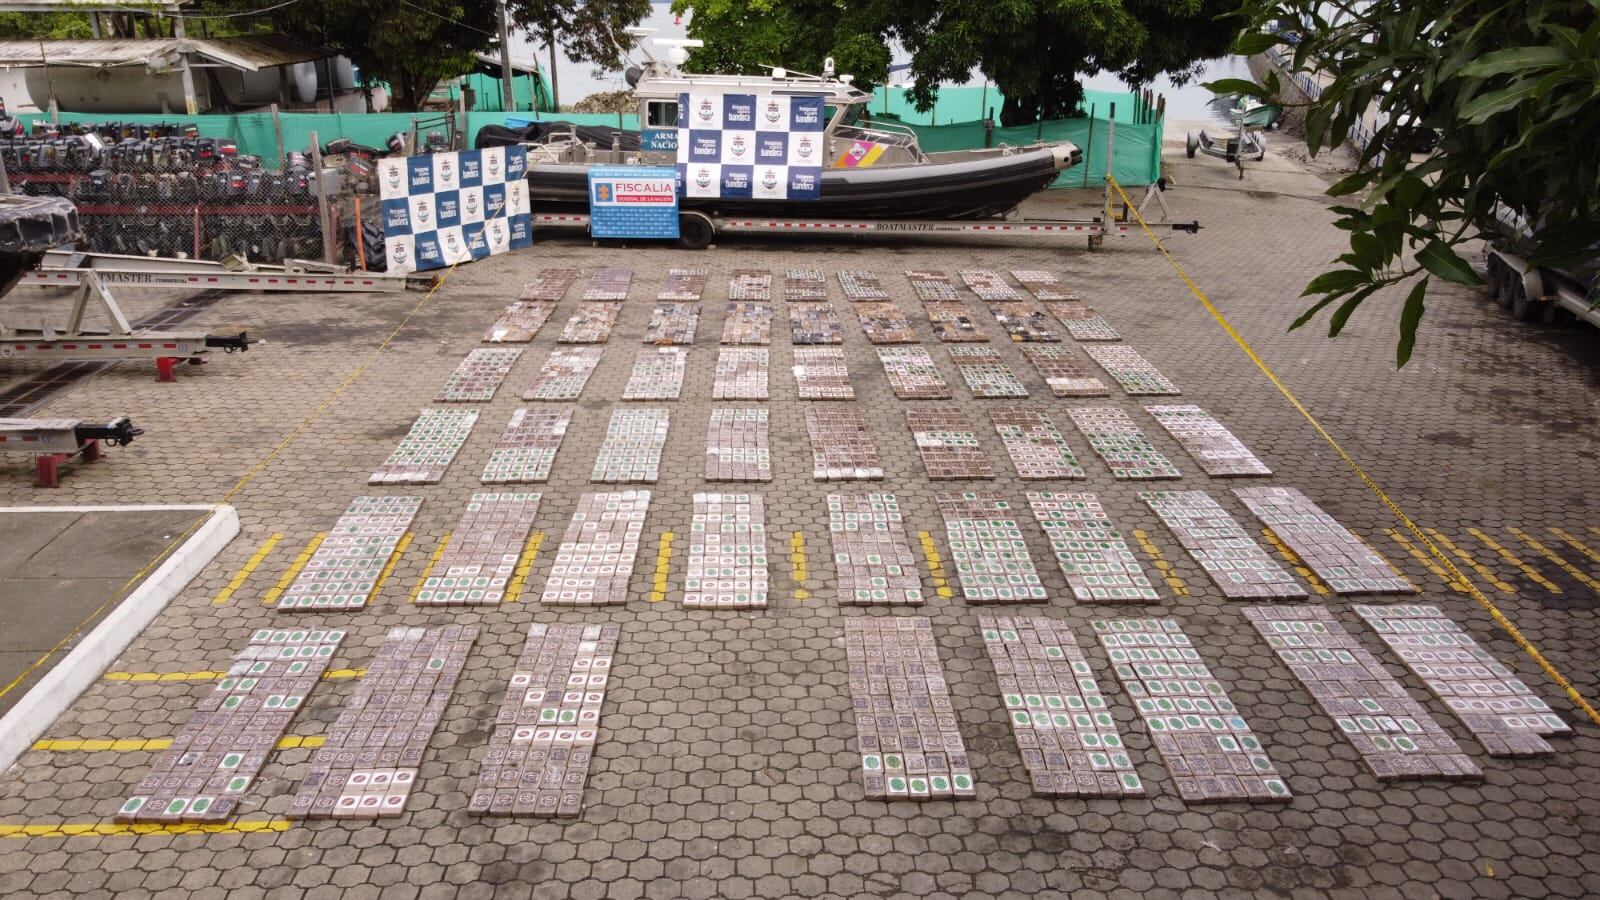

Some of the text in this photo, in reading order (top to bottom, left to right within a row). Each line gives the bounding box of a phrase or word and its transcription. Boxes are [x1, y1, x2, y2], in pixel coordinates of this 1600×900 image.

[654, 132, 678, 140] ARMA
[651, 140, 677, 149] NACIO
[876, 223, 935, 231] BOATMASTER
[76, 272, 152, 283] TMASTER
